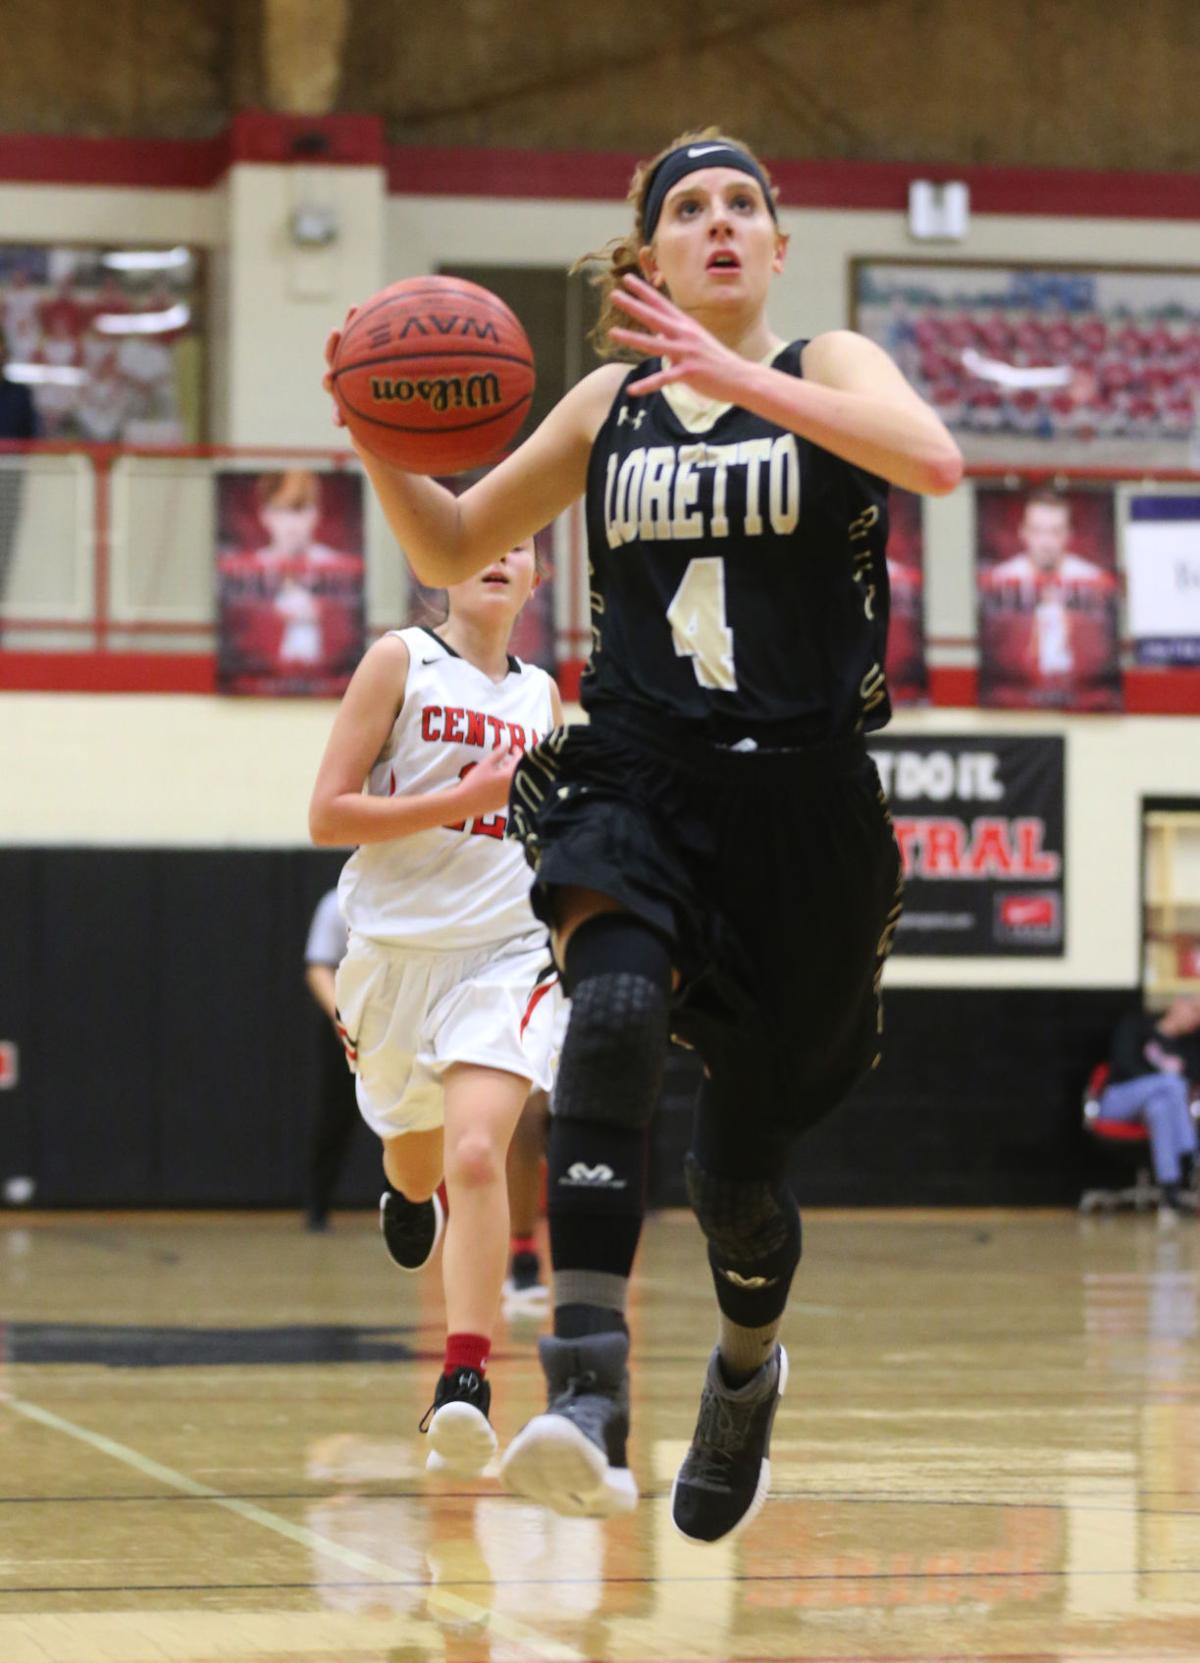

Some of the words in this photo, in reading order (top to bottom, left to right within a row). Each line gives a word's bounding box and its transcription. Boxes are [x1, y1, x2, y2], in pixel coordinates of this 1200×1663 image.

[367, 315, 500, 349] WAVE
[371, 370, 502, 412] Wilson
[604, 433, 801, 549] LORETTO
[666, 555, 738, 692] 4
[421, 705, 545, 755] CENTR
[891, 816, 1060, 881] TRAL
